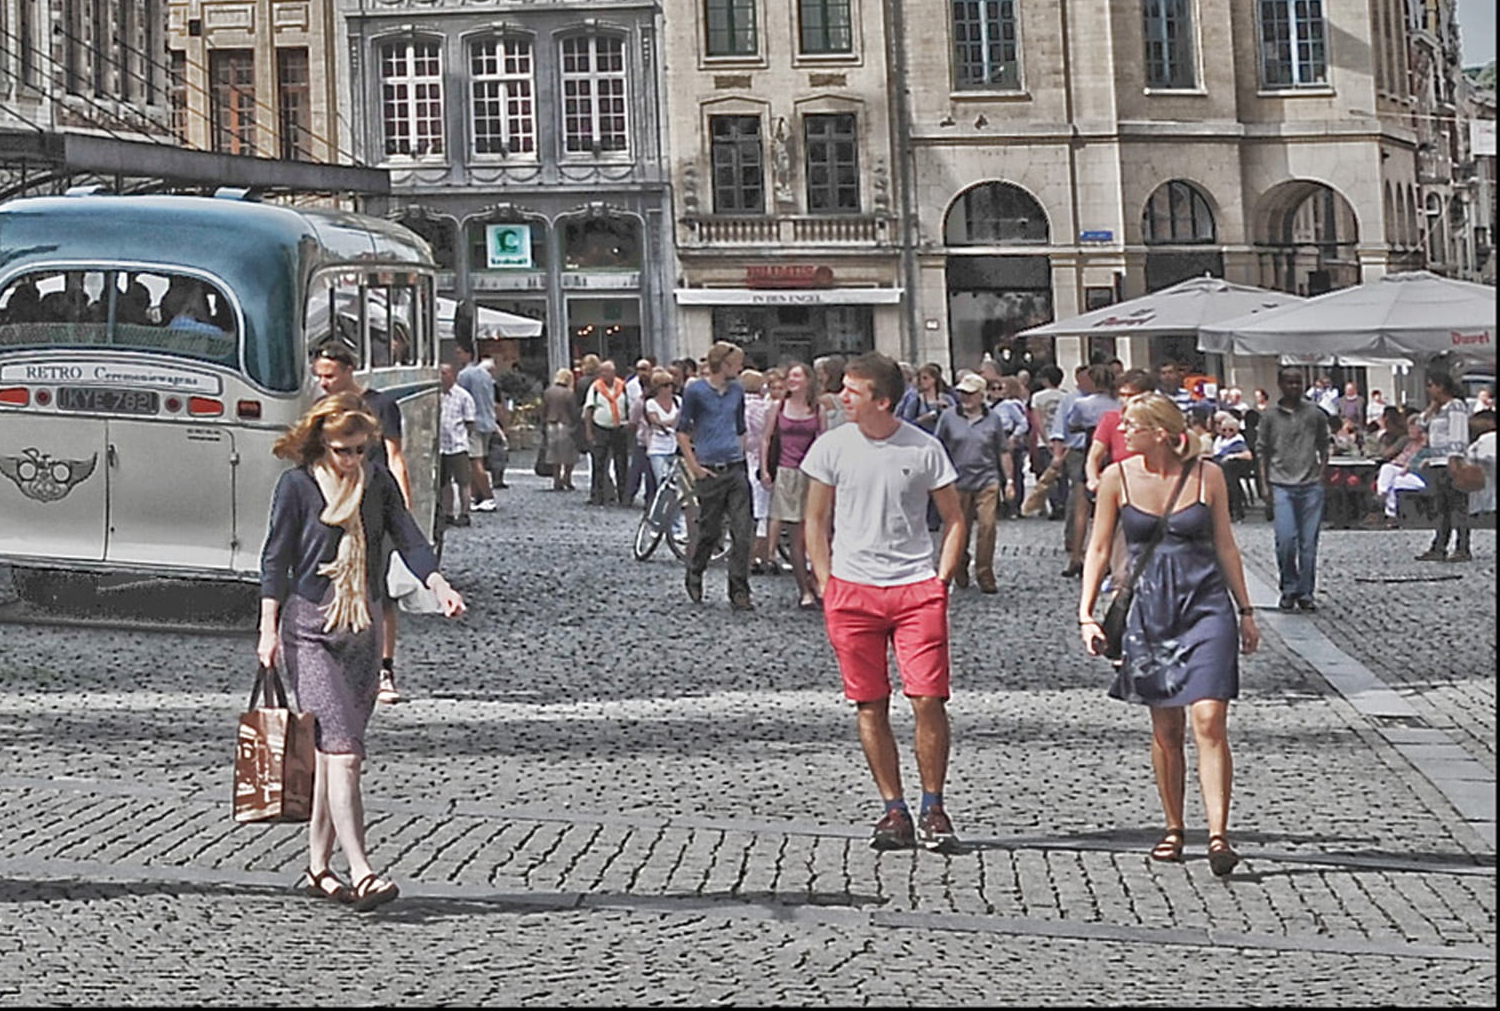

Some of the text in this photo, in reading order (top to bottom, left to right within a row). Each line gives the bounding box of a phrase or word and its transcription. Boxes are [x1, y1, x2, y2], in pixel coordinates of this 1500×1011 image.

[26, 365, 83, 380] RETRO
[69, 389, 150, 412] KYE 782
